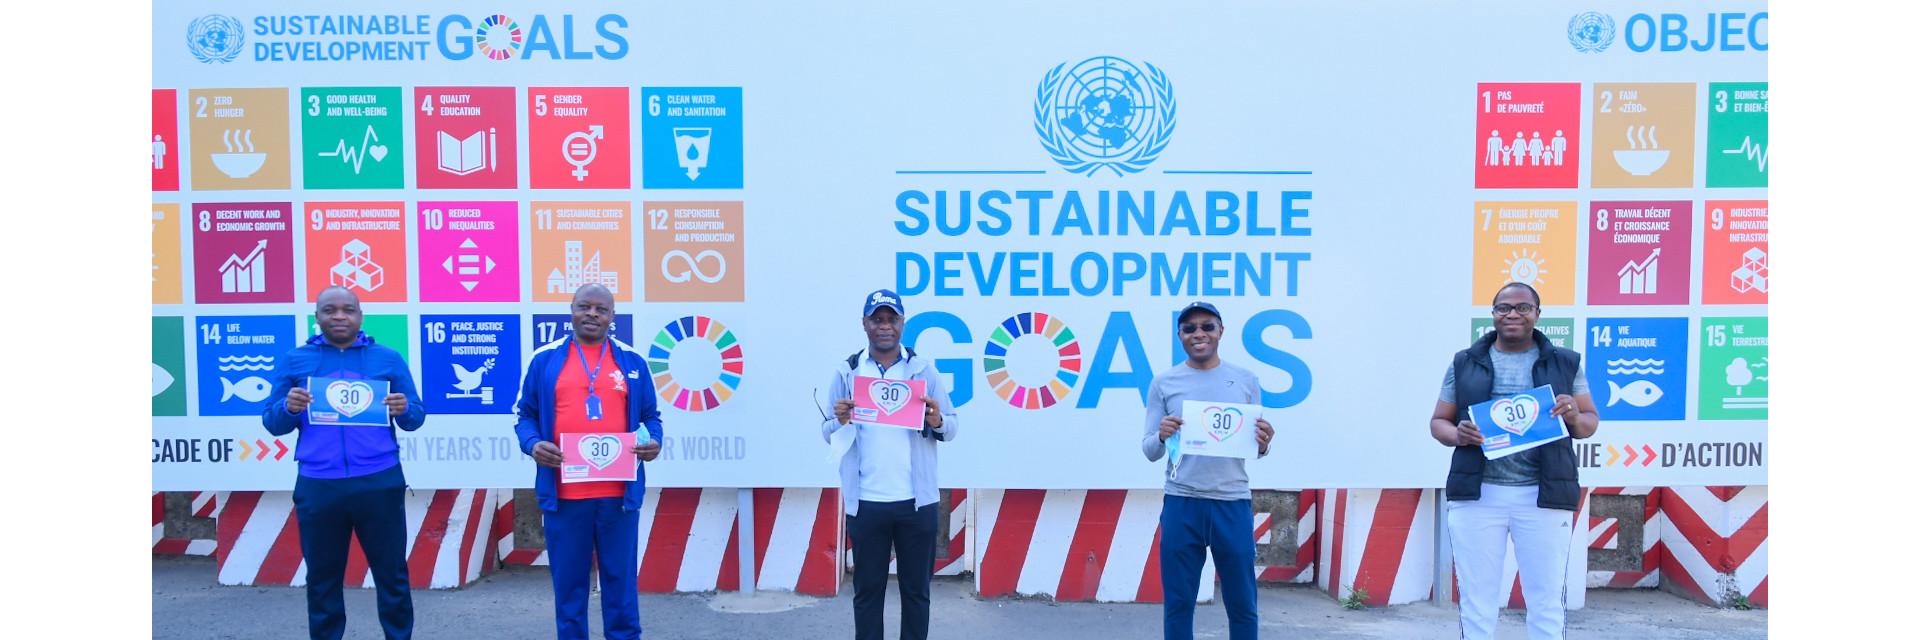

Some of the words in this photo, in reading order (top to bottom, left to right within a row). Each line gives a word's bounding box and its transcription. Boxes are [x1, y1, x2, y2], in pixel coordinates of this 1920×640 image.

[253, 14, 431, 36] SUSTAINABLE
[436, 13, 630, 61] GOALS
[254, 41, 431, 62] DEVELOPMENT
[213, 96, 233, 106] ZERO
[326, 95, 348, 104] GOOD
[349, 95, 377, 104] HEALTH
[439, 94, 471, 105] QUALITY
[553, 95, 583, 105] GENDER
[667, 95, 690, 105] CLEAN
[691, 95, 716, 104] WATER
[1497, 91, 1512, 101] PAS
[1619, 90, 1638, 100] FAIM
[1734, 90, 1759, 100] BONNE
[195, 95, 208, 118] 2
[308, 95, 320, 116] 3
[421, 94, 434, 116] 4
[535, 94, 548, 116] 5
[648, 95, 661, 117] 6
[1482, 91, 1491, 113] 1
[1497, 104, 1507, 113] DE
[1508, 101, 1544, 113] PAUVRETÉ
[1600, 90, 1613, 113] 2
[1715, 90, 1728, 113] 3
[1734, 103, 1744, 112] ET
[213, 108, 245, 118] HUNGER
[326, 107, 343, 116] AND
[344, 107, 388, 117] WELL-BEING
[440, 106, 481, 116] EDUCATION
[553, 107, 588, 118] EQUALITY
[667, 107, 683, 117] AND
[684, 107, 726, 117] SANITATION
[216, 210, 243, 220] DECENT
[243, 210, 264, 219] WORK
[265, 209, 281, 219] AND
[361, 209, 400, 218] INNOVATION
[448, 209, 481, 218] REDUCED
[674, 209, 720, 218] RESPONSIBLE
[894, 189, 1313, 237] SUSTAINABLE
[1614, 208, 1644, 218] TRAVAIL
[1644, 206, 1672, 218] DÉCENT
[199, 210, 212, 232] 8
[311, 209, 324, 231] 9
[422, 209, 443, 231] 10
[535, 209, 553, 231] 11
[648, 209, 669, 231] 12
[1481, 208, 1493, 231] 7
[1596, 209, 1609, 231] 8
[1711, 208, 1724, 231] 9
[216, 222, 254, 232] ECONOMIC
[254, 222, 286, 232] GROWTH
[326, 221, 341, 230] AND
[341, 221, 400, 231] INFRASTRUCTURE
[449, 221, 496, 231] INEQUALITIES
[556, 221, 572, 231] AND
[674, 221, 724, 231] CONSUMPTION
[1614, 221, 1623, 231] ET
[1624, 221, 1670, 231] CROISSANCE
[674, 233, 690, 242] AND
[690, 233, 735, 243] PRODUCTION
[1613, 232, 1661, 244] ÉCONOMIQUE
[895, 251, 1311, 297] DEVELOPMENT
[871, 292, 897, 305] Roma
[226, 323, 240, 332] LIFE
[425, 321, 446, 343] 16
[451, 322, 475, 332] PEACE,
[476, 322, 504, 331] JUSTICE
[537, 322, 558, 343] 17
[1618, 325, 1630, 334] VIE
[1732, 325, 1744, 334] VIE
[201, 323, 221, 345] 14
[227, 335, 251, 345] BELOW
[251, 335, 275, 344] WATER
[451, 334, 466, 343] AND
[467, 334, 497, 343] STRONG
[1591, 325, 1612, 347] 14
[1705, 324, 1726, 347] 15
[1617, 338, 1657, 348] AQUATIQUE
[452, 346, 499, 355] INSTITUTIONS
[340, 389, 360, 405] 30
[881, 387, 899, 401] 30
[1504, 403, 1526, 422] 30
[1212, 413, 1232, 430] 30
[208, 438, 234, 462] OF
[424, 437, 485, 461] YEARS
[488, 437, 511, 461] TO
[591, 442, 609, 457] 30
[683, 437, 746, 461] WORLD
[1662, 442, 1762, 468] D’ACTION
